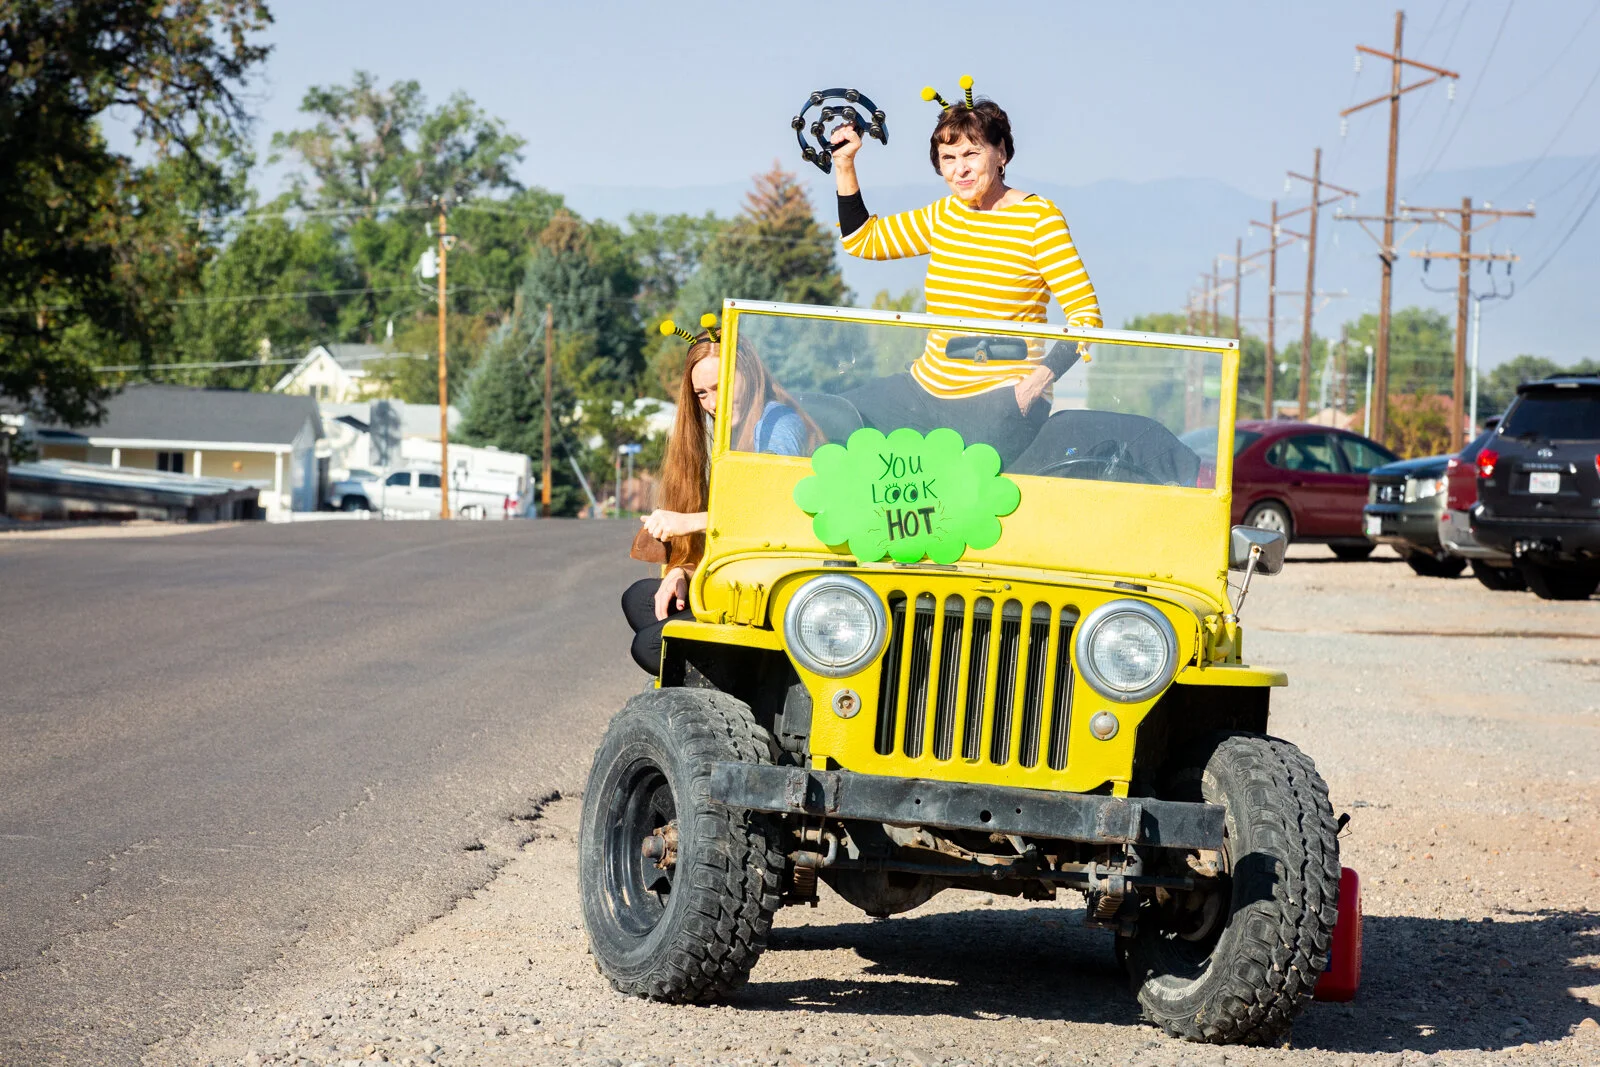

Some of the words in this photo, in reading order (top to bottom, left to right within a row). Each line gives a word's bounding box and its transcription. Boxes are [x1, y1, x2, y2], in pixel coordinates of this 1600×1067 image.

[878, 452, 923, 481] YOU
[871, 478, 938, 505] LOOK
[886, 506, 936, 542] HOT
